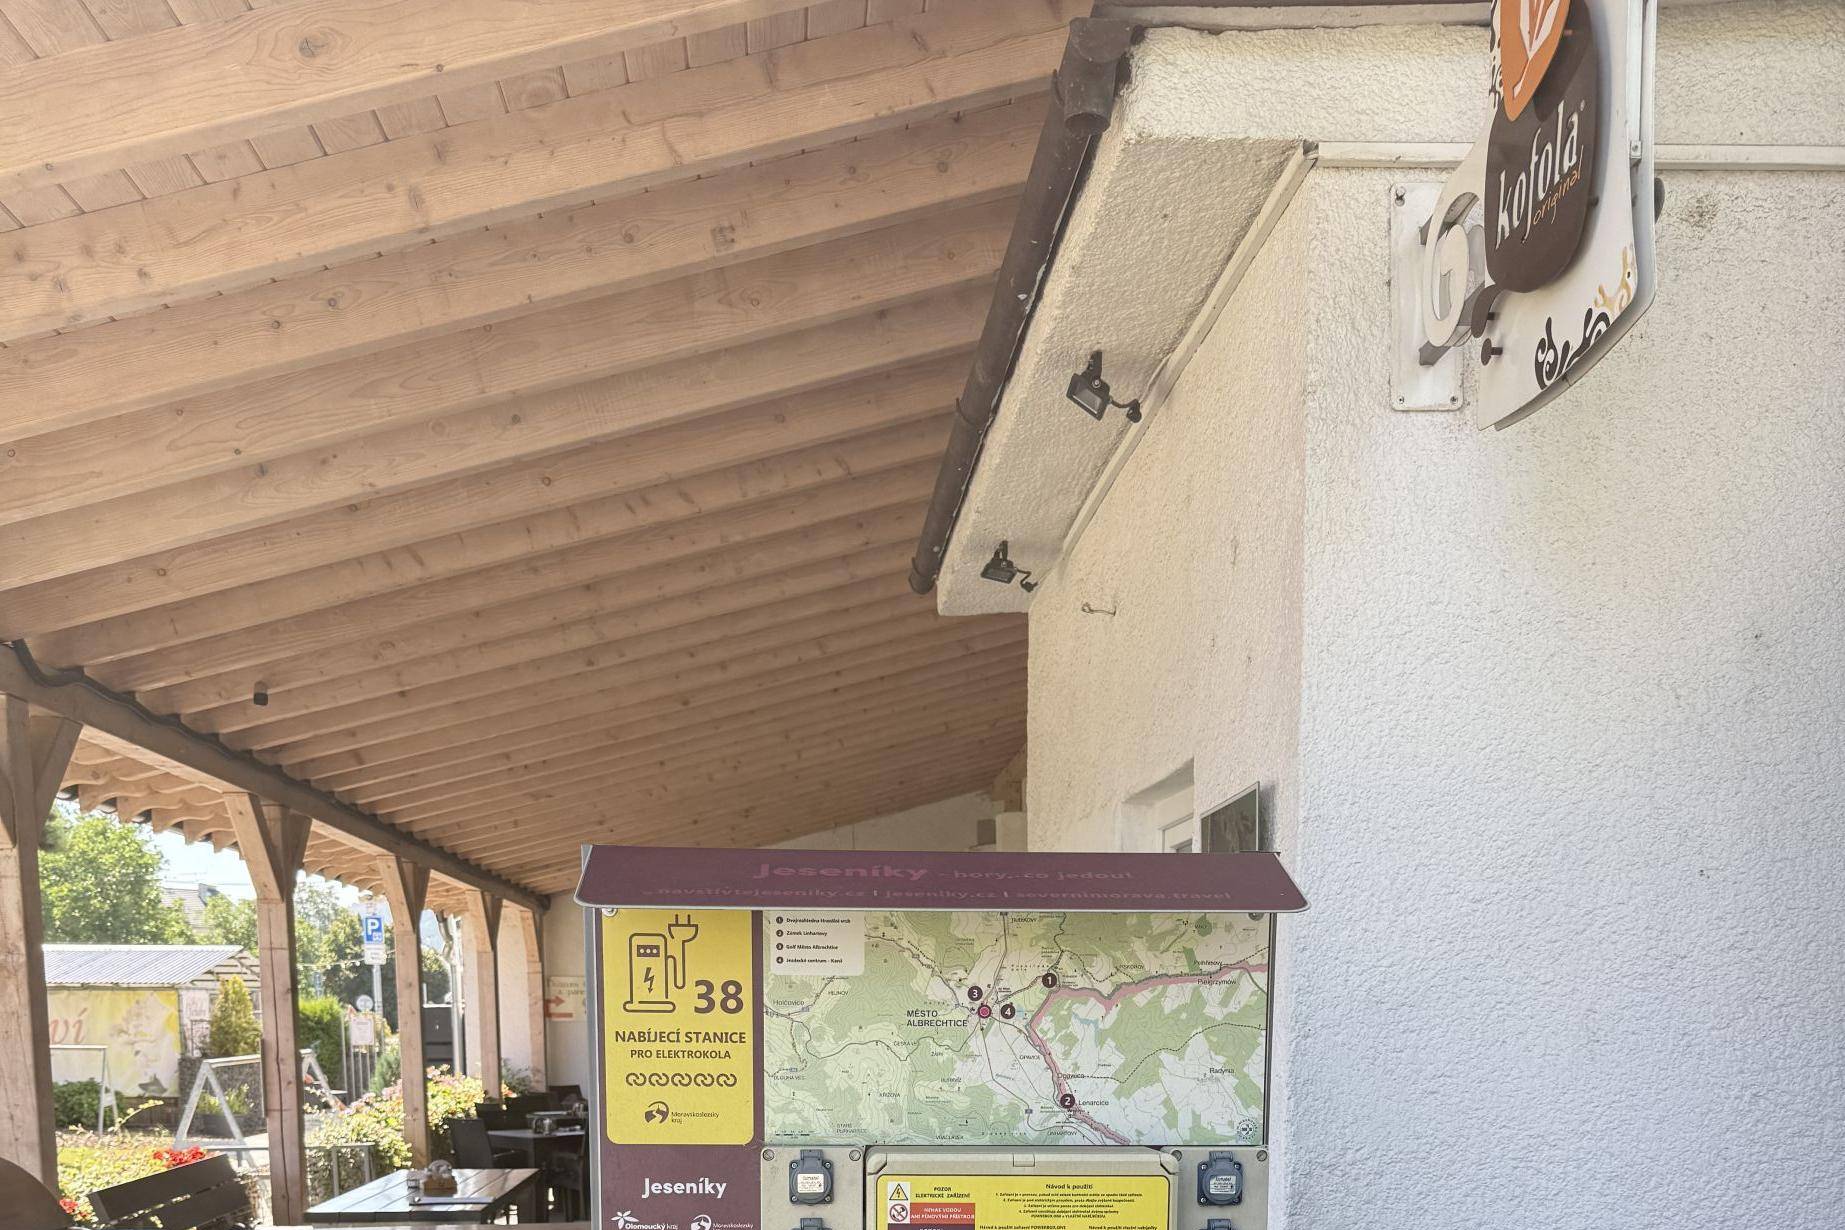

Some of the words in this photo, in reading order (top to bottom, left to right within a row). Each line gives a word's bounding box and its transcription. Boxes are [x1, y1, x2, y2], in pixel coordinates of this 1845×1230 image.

[1496, 100, 1578, 250] kofola
[1533, 145, 1584, 225] original
[753, 863, 927, 881] Jeseníky
[367, 919, 379, 935] P
[693, 979, 744, 1014] 38
[906, 1009, 938, 1017] MĚSTO
[615, 1028, 681, 1044] NABÍJECÍ
[684, 1031, 746, 1044] STANICE
[630, 1050, 652, 1059] PRO
[656, 1050, 731, 1059] ELEKTROKOLA
[641, 1177, 727, 1199] Jeseníky
[625, 1223, 666, 1230] Olomoucký
[666, 1223, 678, 1230] kraj
